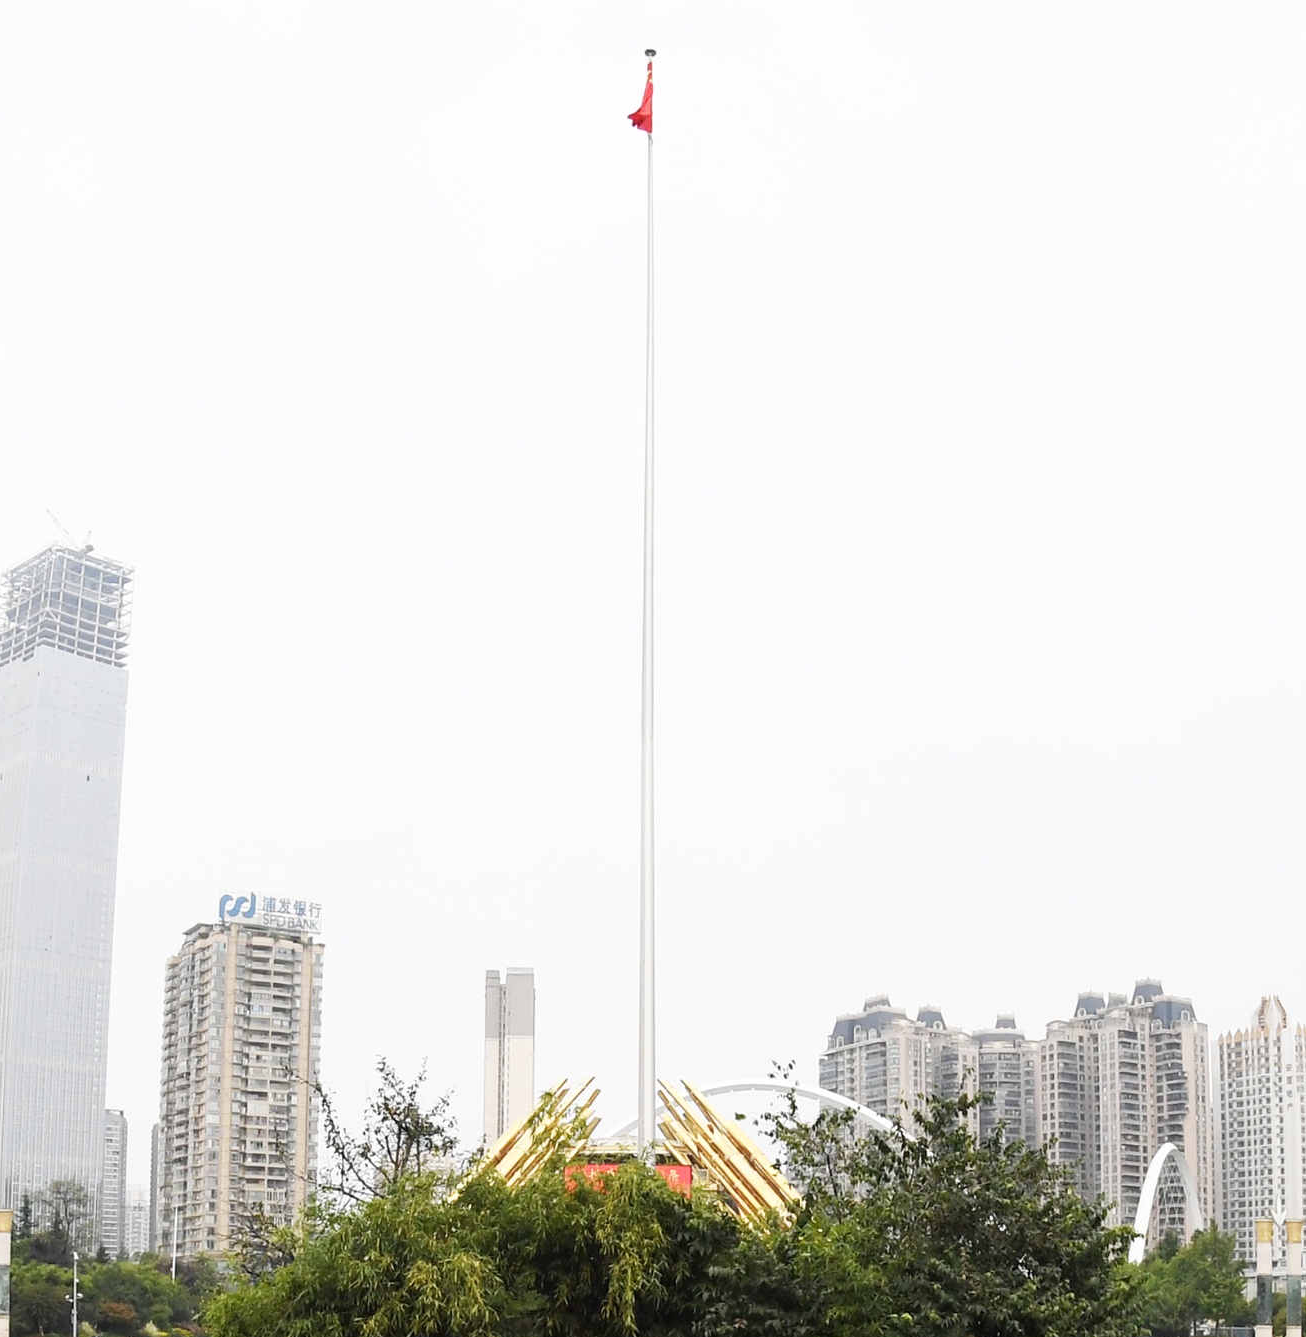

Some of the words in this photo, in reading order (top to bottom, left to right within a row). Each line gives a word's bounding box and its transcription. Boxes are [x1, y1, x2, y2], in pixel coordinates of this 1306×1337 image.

[261, 896, 322, 918] 浦发银行
[287, 917, 319, 931] BANK
